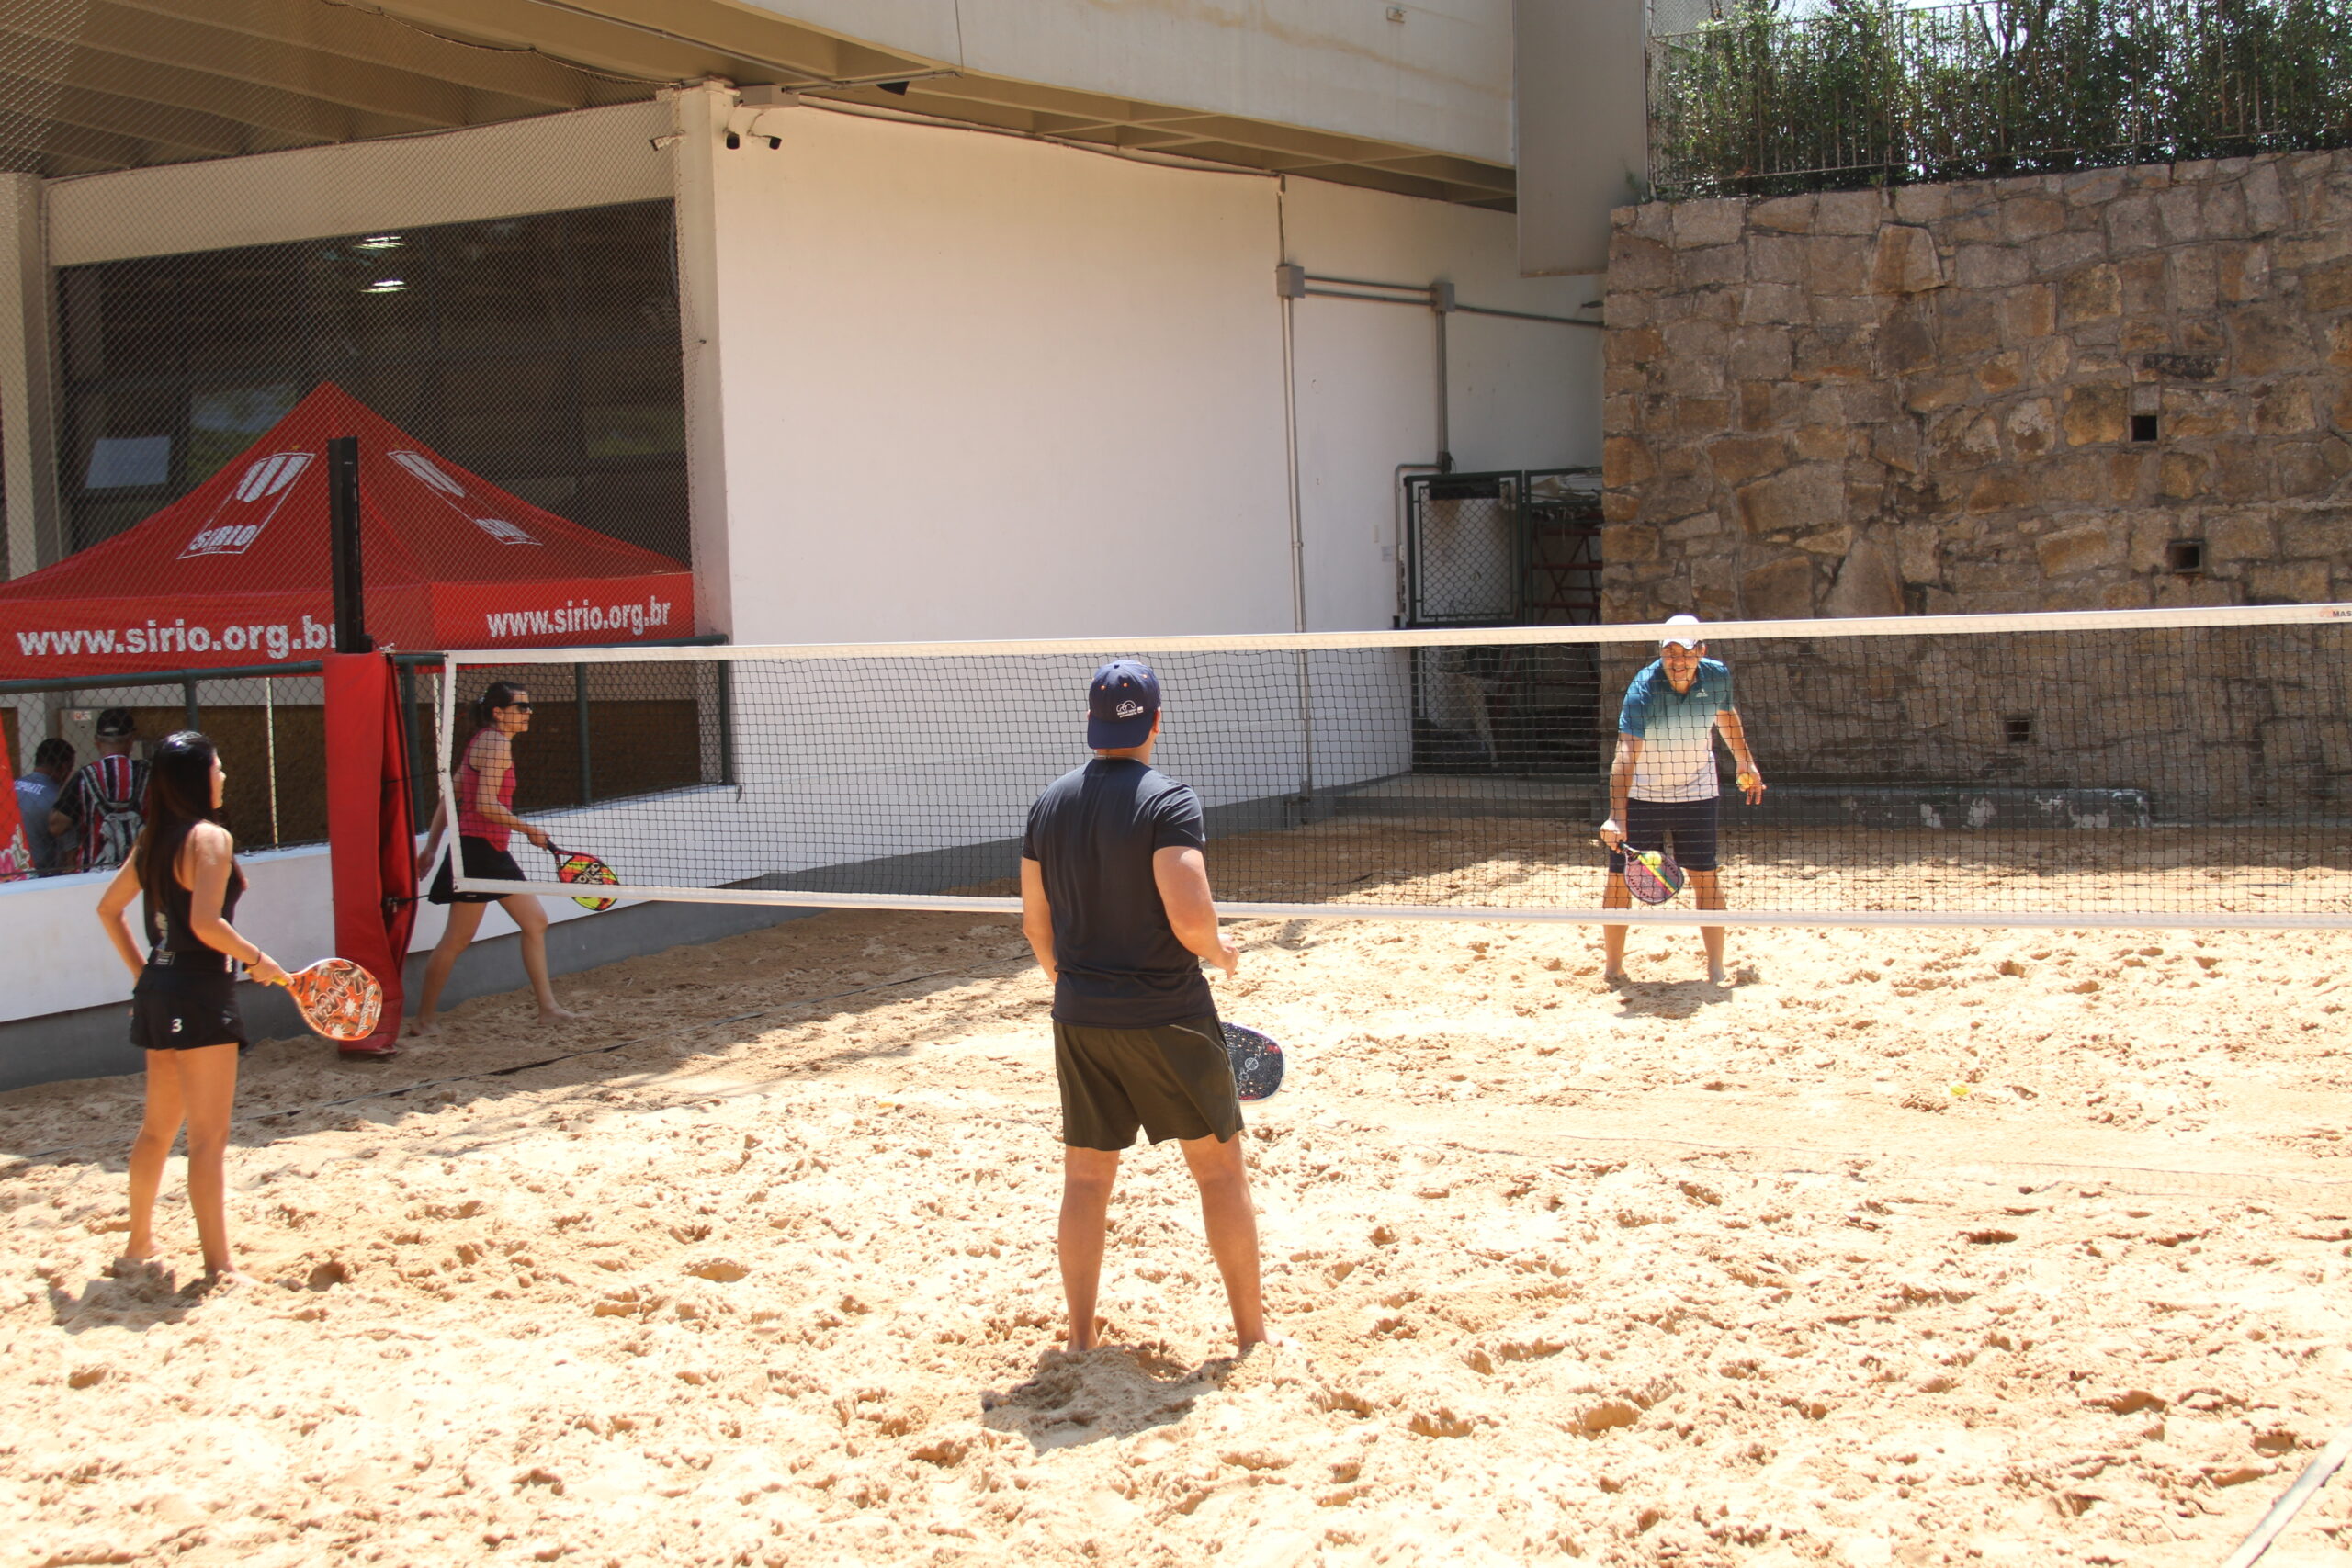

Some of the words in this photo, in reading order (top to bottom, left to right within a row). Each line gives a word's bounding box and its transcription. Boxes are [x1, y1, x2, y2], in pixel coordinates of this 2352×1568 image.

[189, 525, 258, 551] SIRIO
[486, 595, 671, 637] www.sirio.org.br
[171, 1018, 183, 1033] 3
